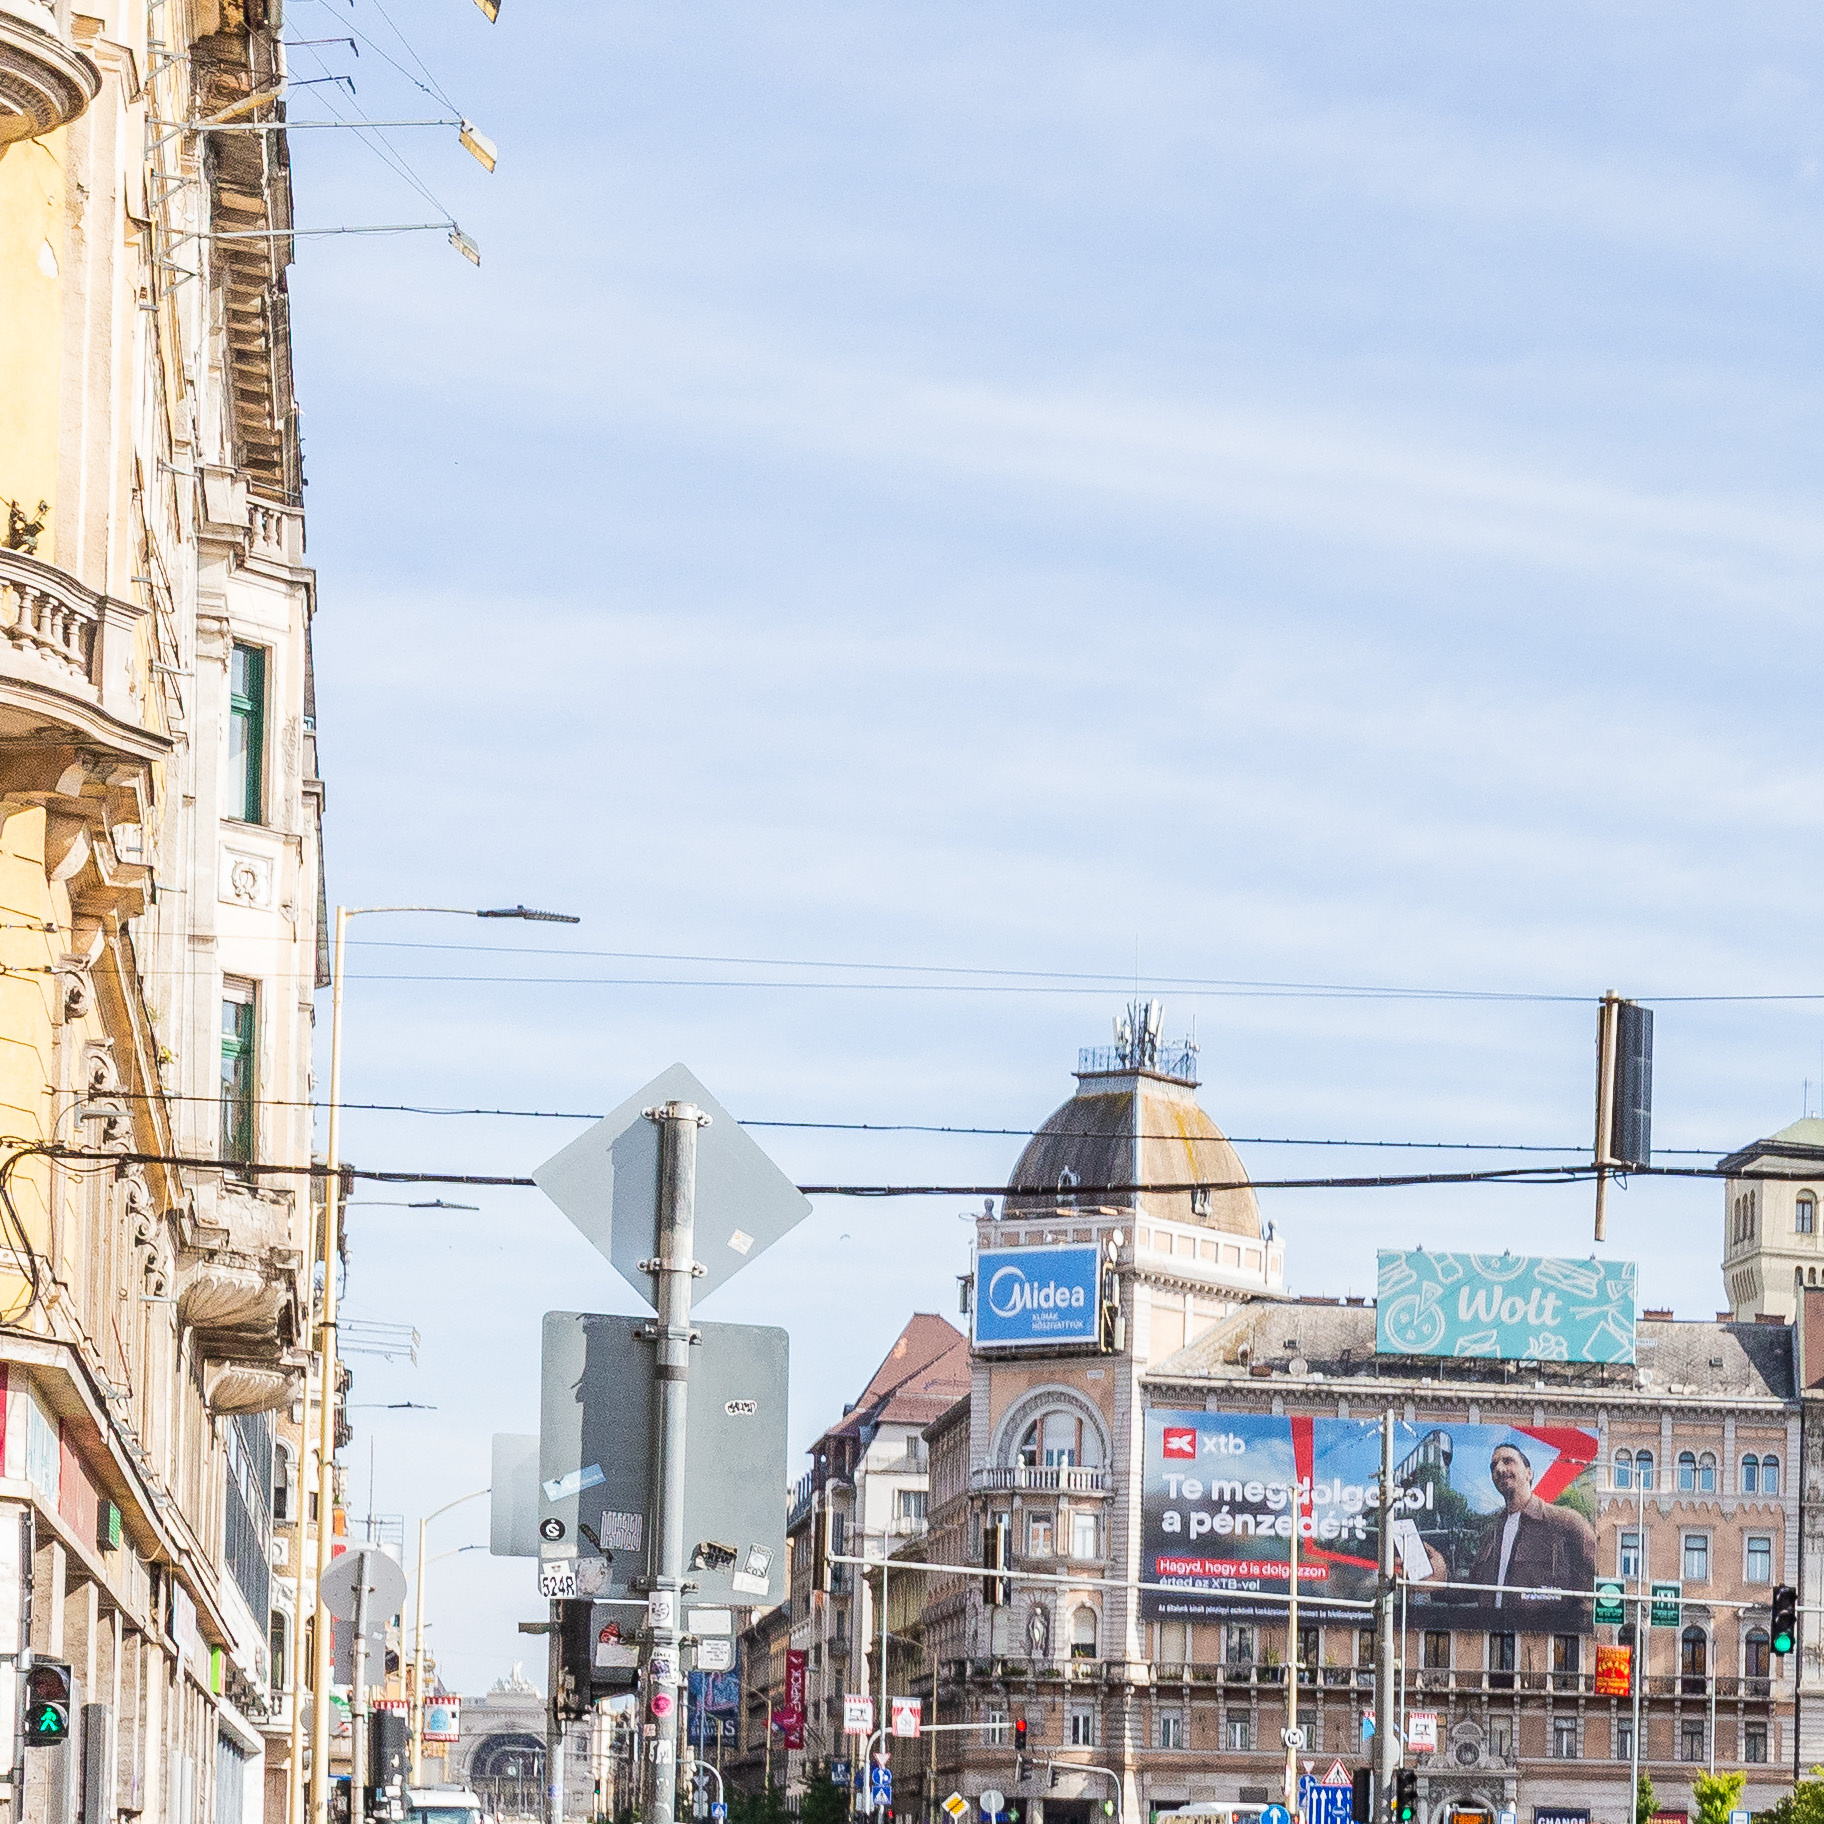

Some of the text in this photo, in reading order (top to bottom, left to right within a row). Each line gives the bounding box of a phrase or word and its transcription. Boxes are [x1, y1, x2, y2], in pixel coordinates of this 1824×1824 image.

[995, 1274, 1085, 1313] Midea
[1457, 1285, 1563, 1326] Wolt
[1202, 1431, 1247, 1456] xtb
[1161, 1473, 1203, 1501] Te
[1161, 1506, 1367, 1541] a pénzedért
[1159, 1559, 1202, 1576] Hagyd,
[1205, 1561, 1237, 1577] hogy
[1250, 1562, 1260, 1576] is
[1261, 1561, 1327, 1579] dolgzzon
[542, 1574, 575, 1597] 524R
[1211, 1578, 1261, 1591] XTB-vel
